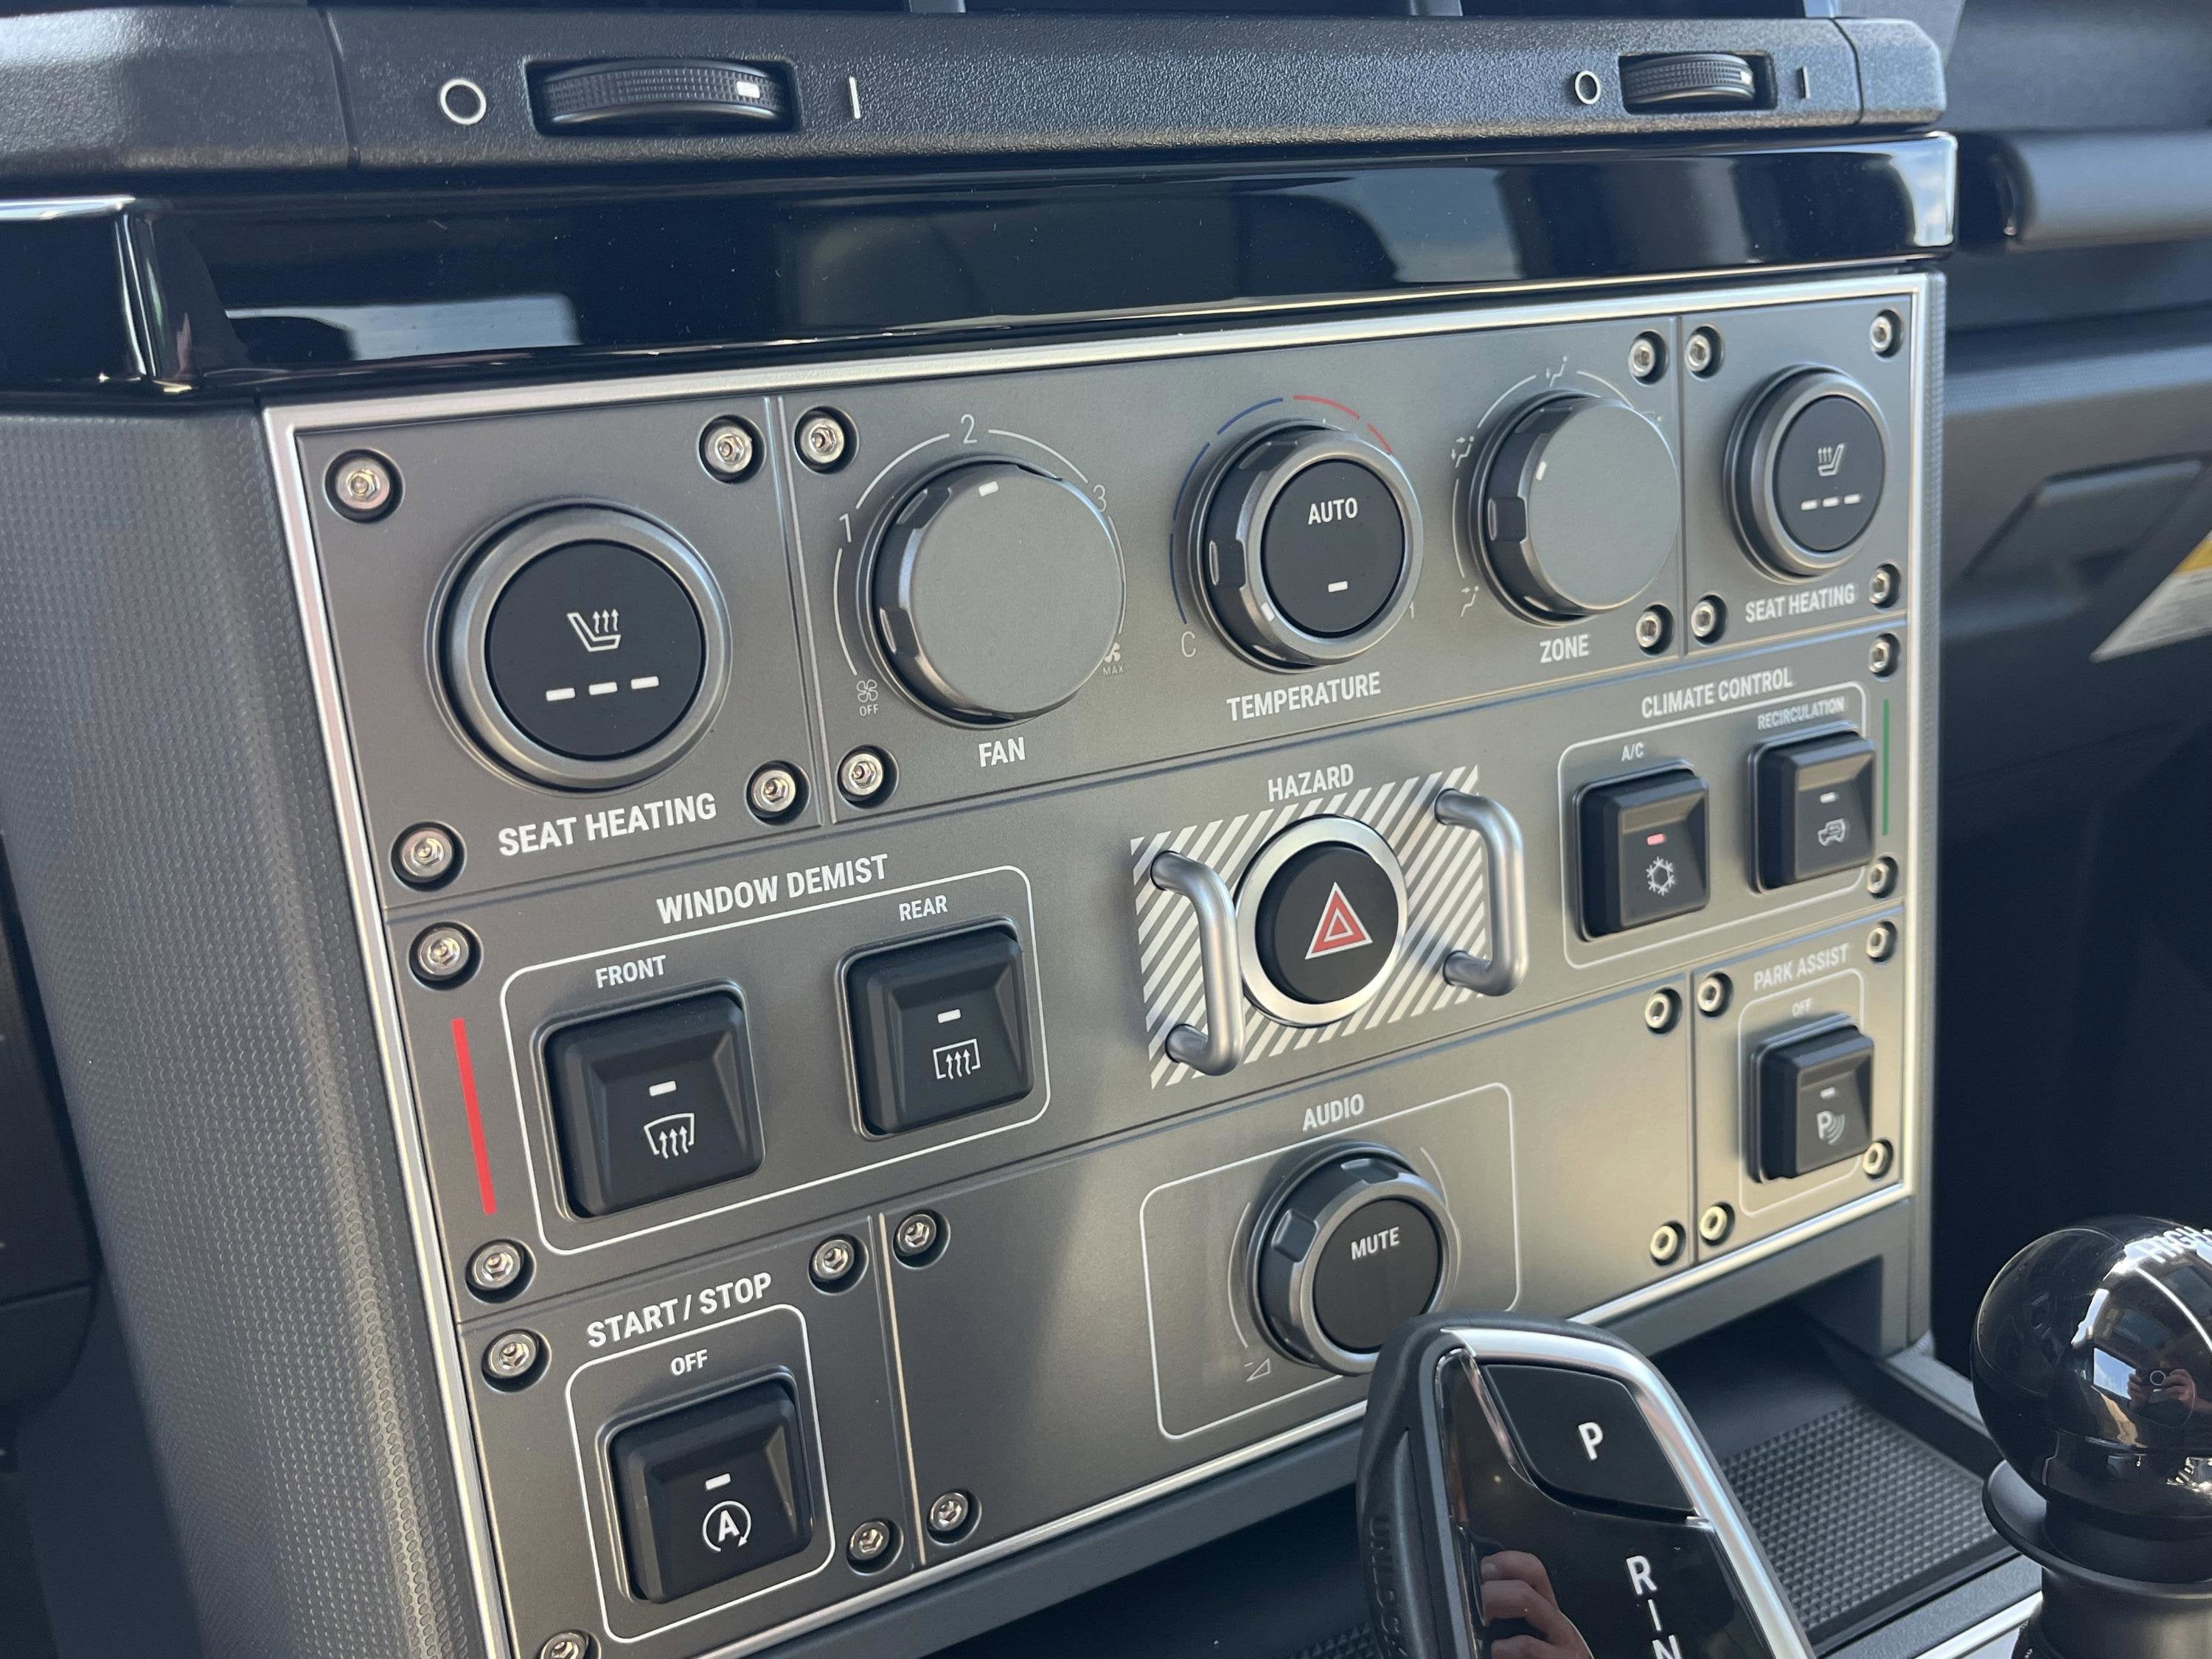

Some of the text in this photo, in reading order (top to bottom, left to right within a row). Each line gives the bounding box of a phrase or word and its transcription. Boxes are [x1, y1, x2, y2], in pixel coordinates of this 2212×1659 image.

[961, 414, 978, 444] 2
[1093, 484, 1107, 512] 3
[1308, 497, 1358, 525] AUTO
[839, 513, 852, 543] 1
[1745, 582, 1855, 622] SEAT HEATING
[1180, 632, 1197, 658] C
[1540, 635, 1590, 663] ZONE
[1102, 664, 1124, 677] MAX
[1226, 672, 1381, 721] TEMPERATURE
[1641, 667, 1793, 720] CLIMATE CONTROL
[859, 704, 879, 717] OFF
[1757, 697, 1845, 730] RECIRCULATION
[978, 737, 1026, 767] FAN
[1621, 742, 1644, 763] A/C
[1267, 763, 1354, 803] HAZARD
[498, 793, 717, 856] SEAT HEATING
[656, 854, 888, 925] WINDOW DEMIST
[899, 895, 948, 922] REAR
[595, 956, 667, 988] FRONT
[1753, 944, 1848, 991] PARK ASSIST
[1792, 998, 1813, 1017] OFF
[1302, 1093, 1365, 1132] AUDIO
[1350, 1227, 1400, 1260] MUTE
[587, 1298, 678, 1348] START
[699, 1272, 772, 1314] STOP
[670, 1349, 708, 1376] OFF
[1578, 1422, 1603, 1461] P
[717, 1510, 740, 1542] A
[1626, 1555, 1657, 1595] R
[1652, 1635, 1682, 1659] N
